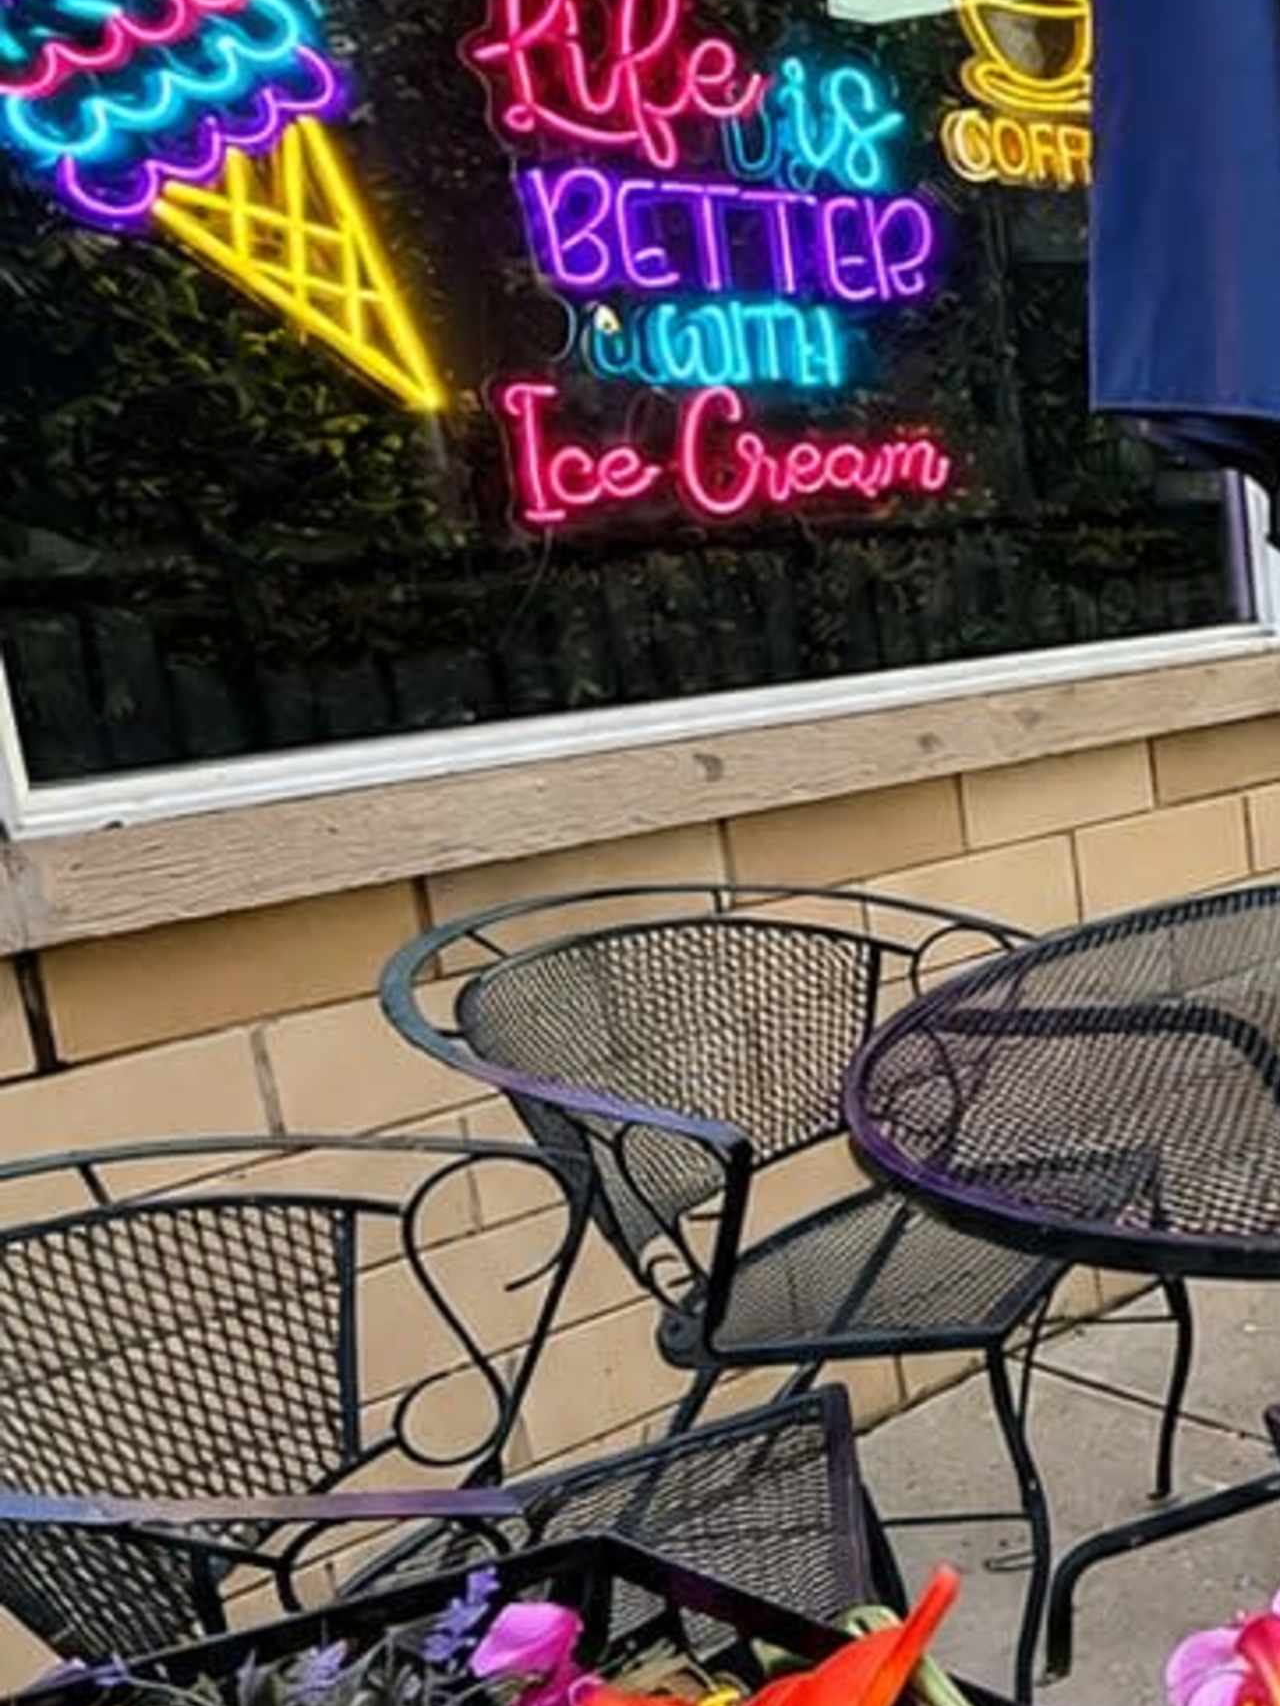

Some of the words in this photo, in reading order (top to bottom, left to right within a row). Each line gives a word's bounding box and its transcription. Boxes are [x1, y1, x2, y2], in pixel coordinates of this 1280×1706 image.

[774, 56, 904, 187] is
[527, 167, 936, 301] BETTER
[652, 301, 841, 387] WITH
[504, 382, 662, 522] Ice
[680, 385, 950, 514] Cream
